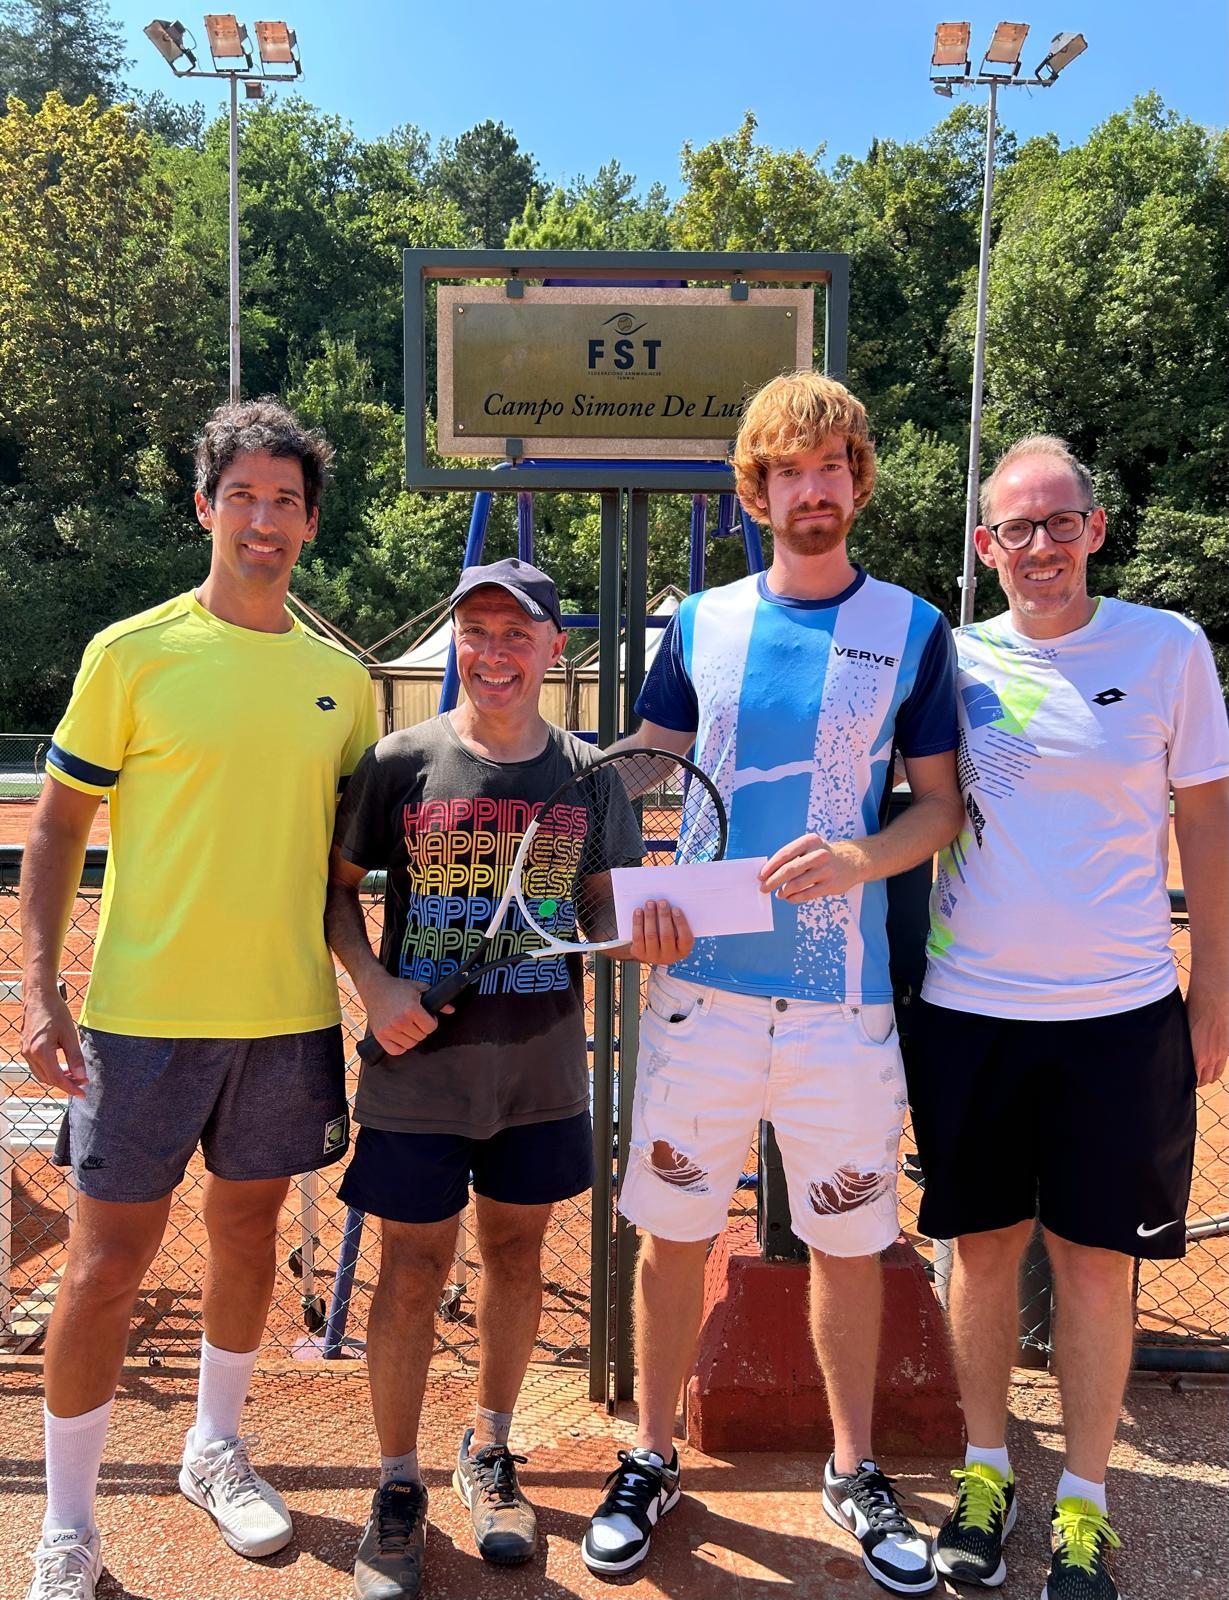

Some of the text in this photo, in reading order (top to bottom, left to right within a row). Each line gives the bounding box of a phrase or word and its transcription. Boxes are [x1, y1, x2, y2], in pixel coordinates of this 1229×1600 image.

[588, 339, 662, 370] FST
[484, 393, 564, 425] Campo
[571, 393, 656, 417] Simone
[661, 395, 696, 417] De
[834, 646, 896, 668] VERVE
[850, 660, 880, 670] MILANO
